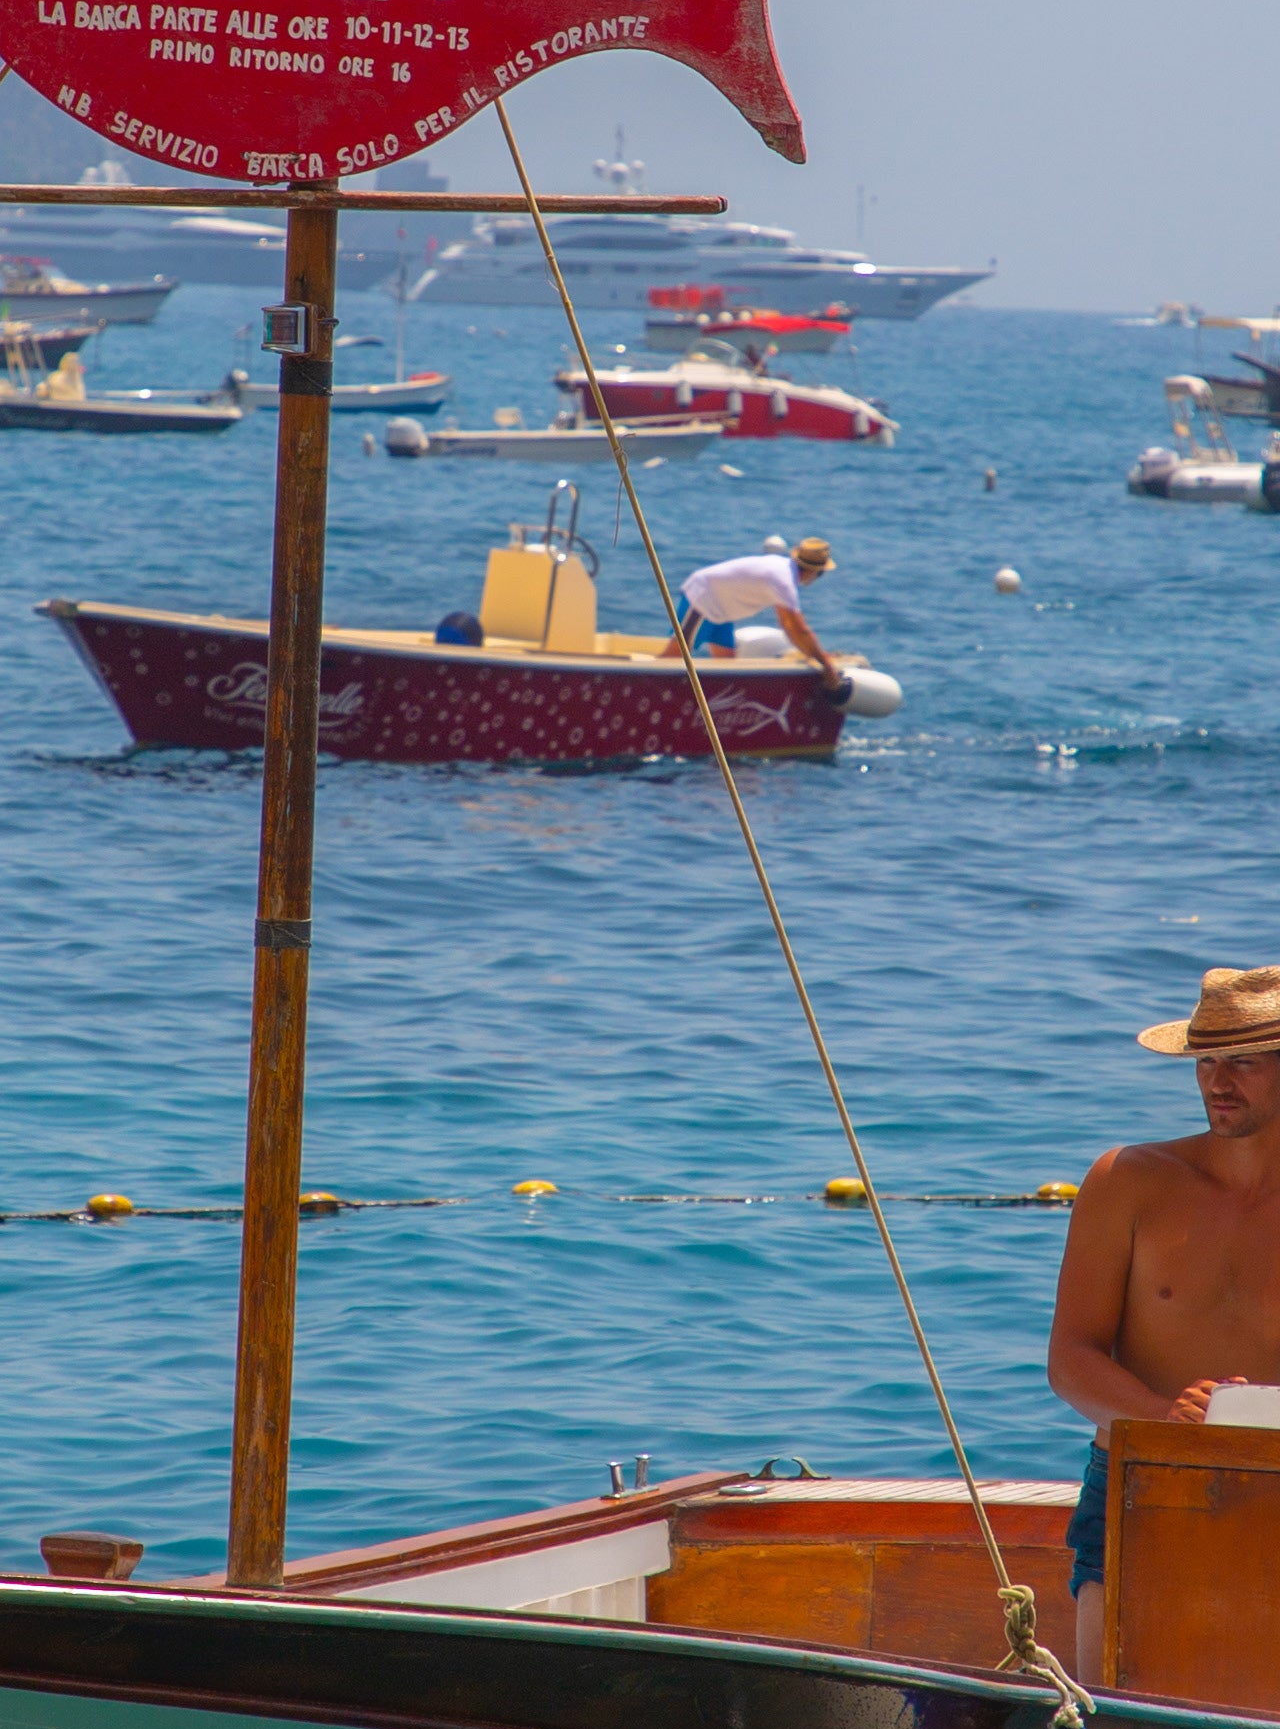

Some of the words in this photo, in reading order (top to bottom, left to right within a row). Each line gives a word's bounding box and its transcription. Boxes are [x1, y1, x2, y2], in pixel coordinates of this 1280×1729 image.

[38, 0, 67, 26] LA
[74, 0, 141, 31] BARCA
[150, 4, 218, 33] PARTE
[225, 9, 279, 41] ALLE
[287, 16, 329, 41] ORE
[345, 16, 470, 51] 10-11-12-13
[150, 38, 215, 64] PRIMO
[229, 46, 325, 74] RITORNO
[338, 55, 375, 78] ORE
[391, 62, 411, 83] 16
[110, 111, 219, 169] SERVIZIO
[245, 151, 325, 179] BARCA
[336, 133, 399, 174] SOLO
[414, 106, 456, 142] PER
[462, 86, 488, 110] IL
[493, 15, 650, 88] RISTORANTE
